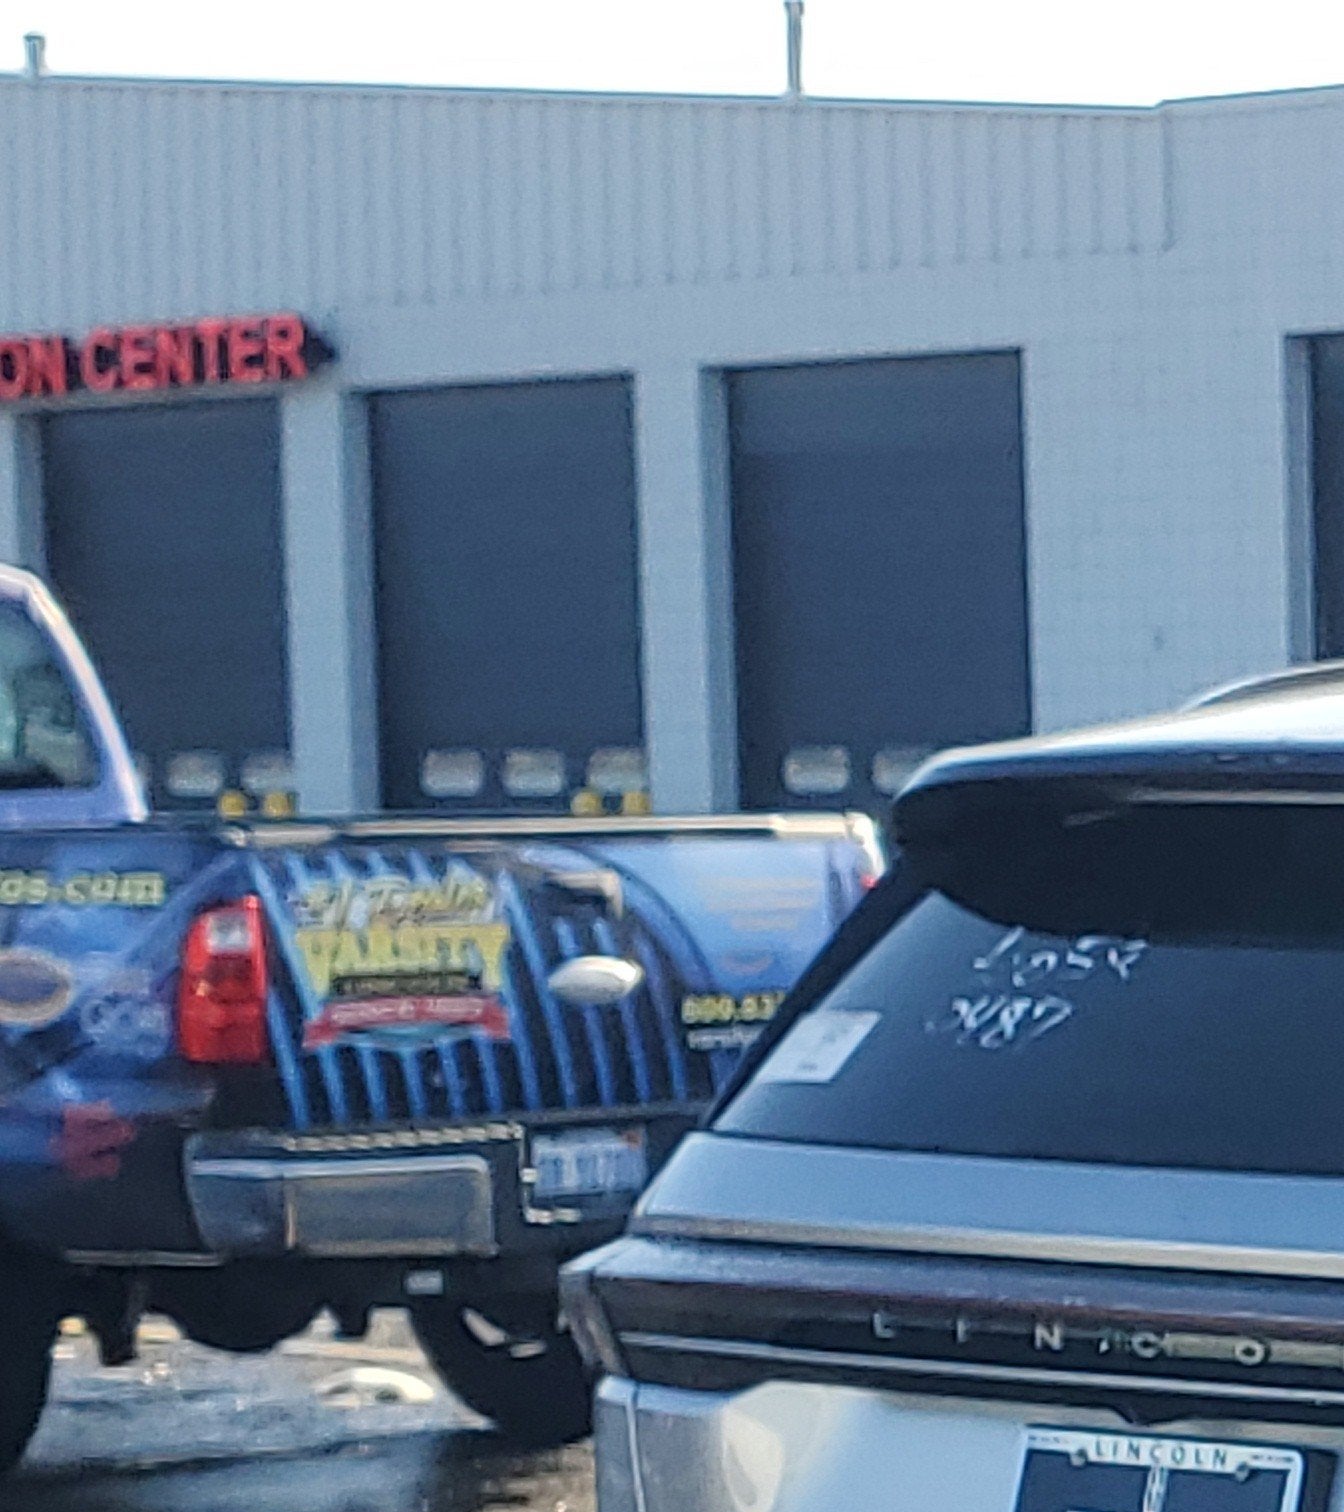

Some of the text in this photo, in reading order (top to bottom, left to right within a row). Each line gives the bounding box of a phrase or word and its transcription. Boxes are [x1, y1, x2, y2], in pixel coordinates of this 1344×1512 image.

[0, 311, 308, 398] ON CENTER
[1095, 1440, 1228, 1467] LINCOLN
